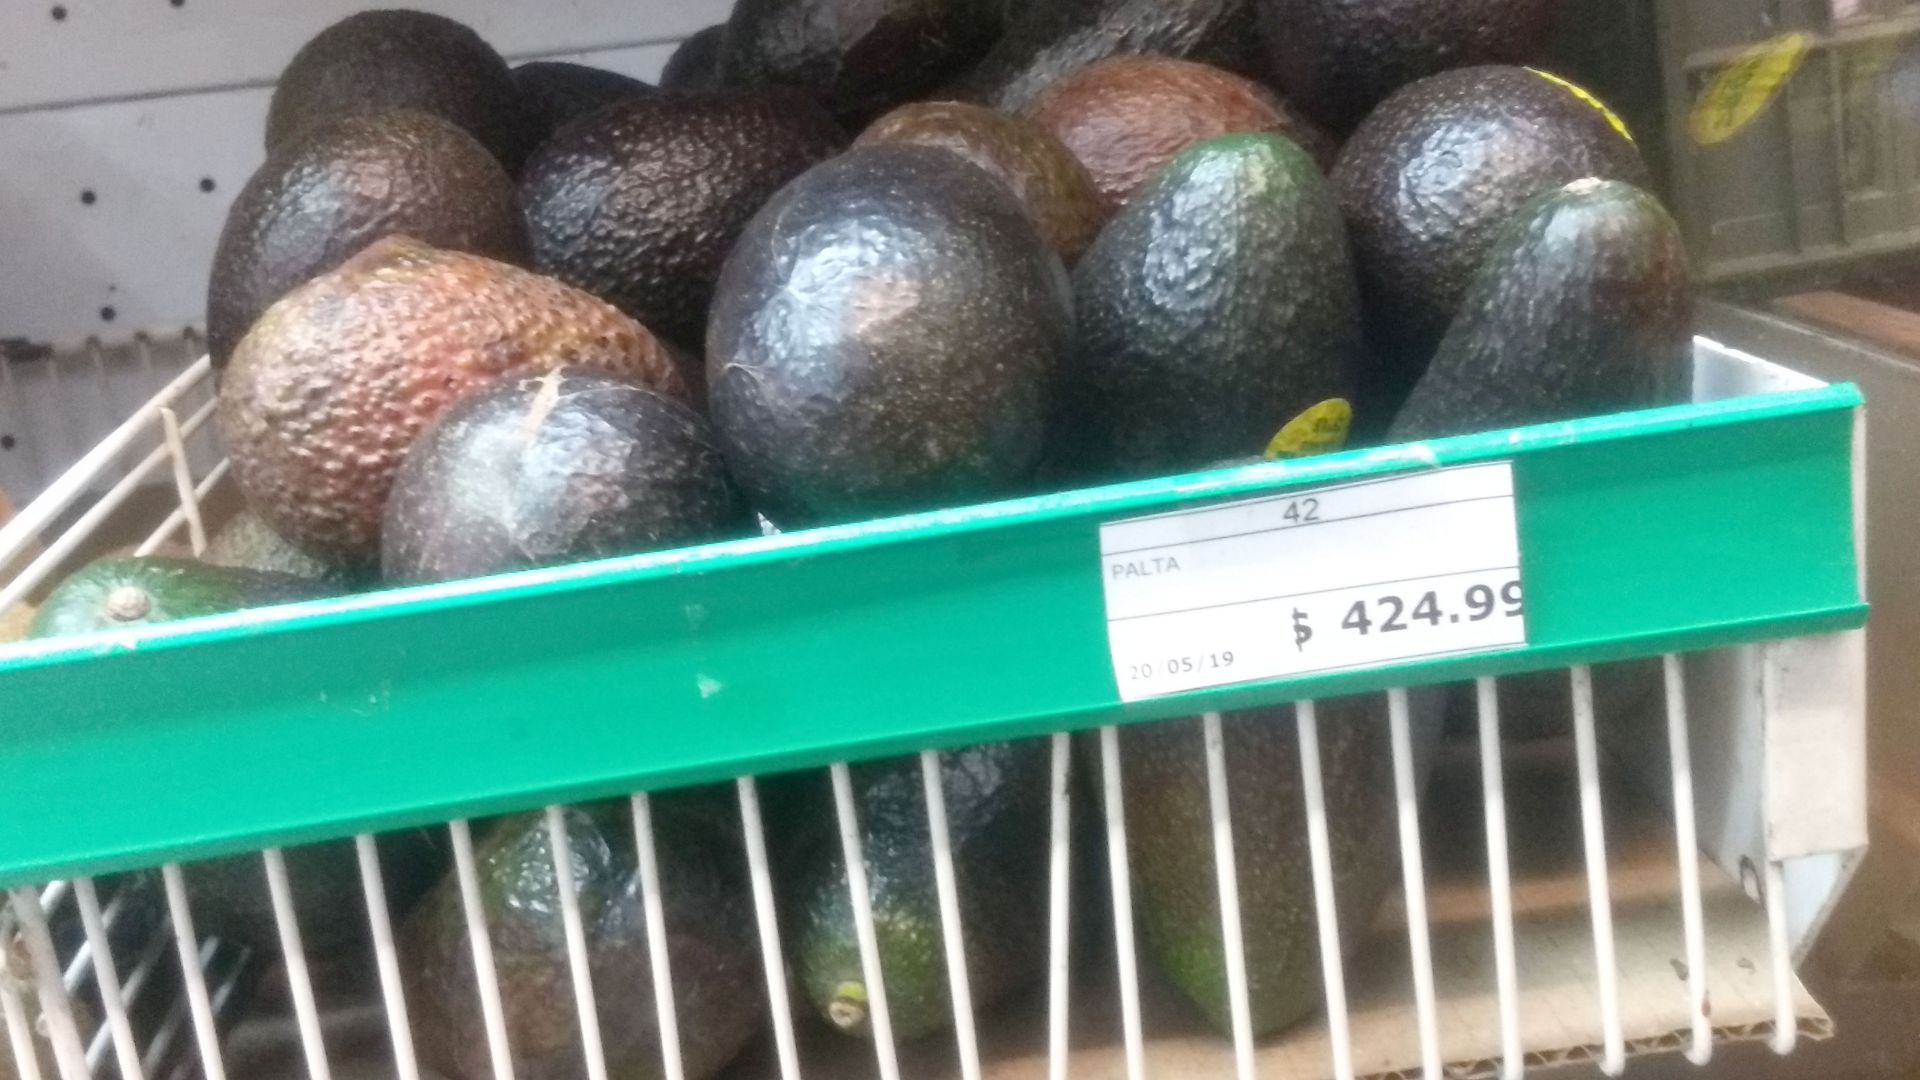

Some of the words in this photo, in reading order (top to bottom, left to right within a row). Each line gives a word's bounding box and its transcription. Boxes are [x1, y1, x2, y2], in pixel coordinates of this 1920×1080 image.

[1282, 498, 1319, 523] 42
[1111, 556, 1180, 581] PALTA
[1291, 606, 1314, 652] $
[1341, 580, 1524, 636] 424.99
[1130, 650, 1235, 681] 20/05/19
